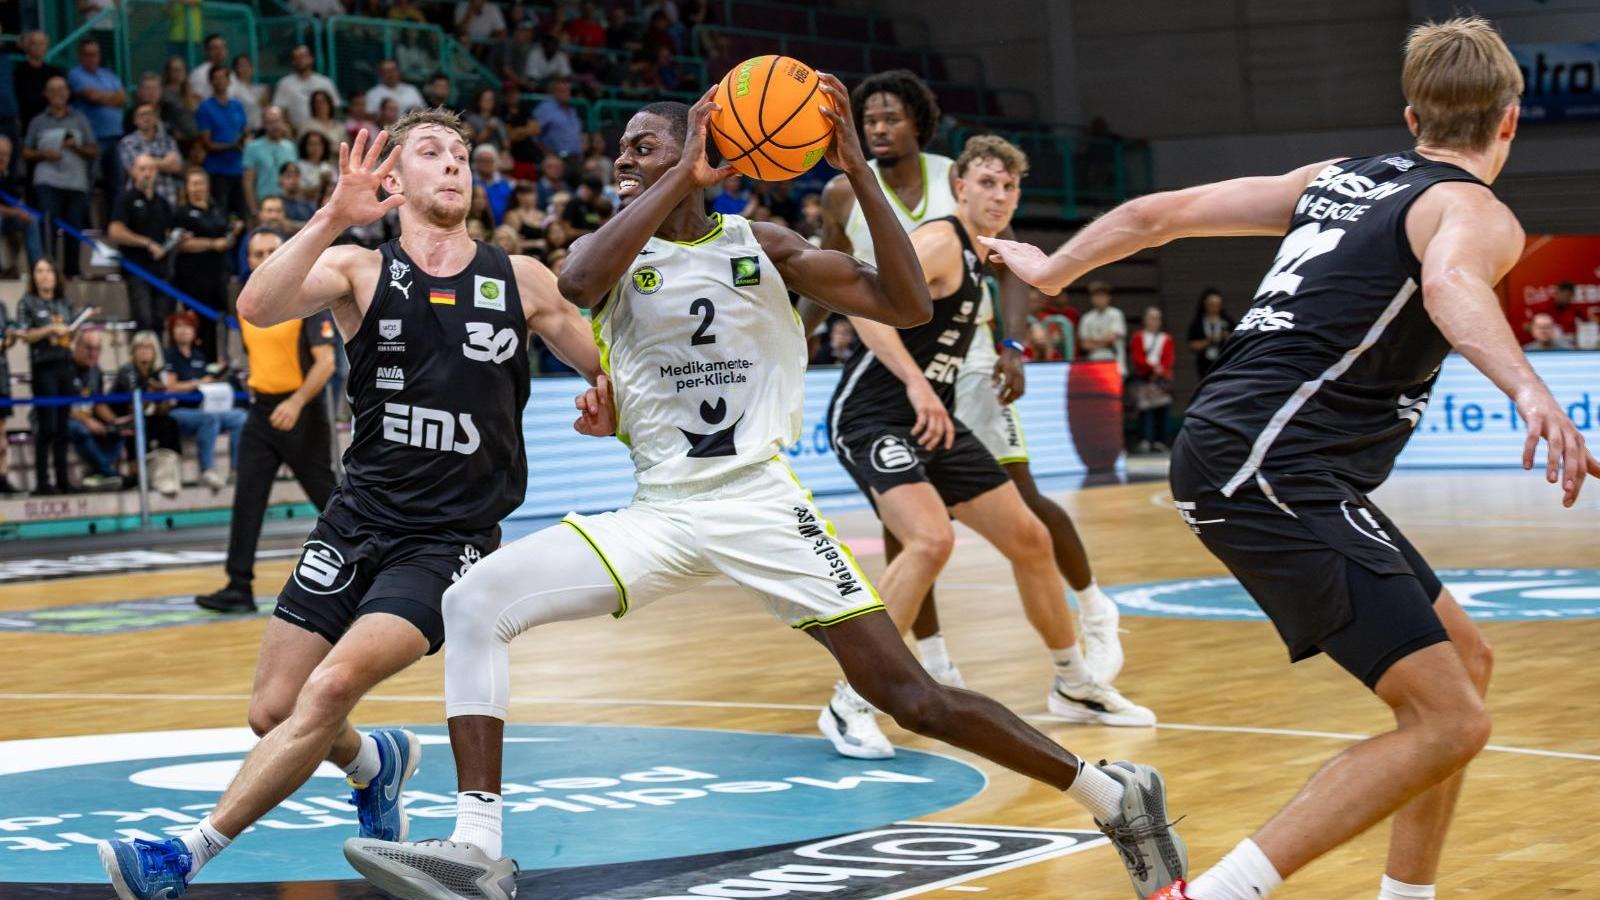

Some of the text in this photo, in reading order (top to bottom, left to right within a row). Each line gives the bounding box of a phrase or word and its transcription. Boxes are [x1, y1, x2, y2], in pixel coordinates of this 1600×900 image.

[462, 322, 519, 364] 30
[689, 297, 716, 346] 2
[383, 402, 481, 455] EMS
